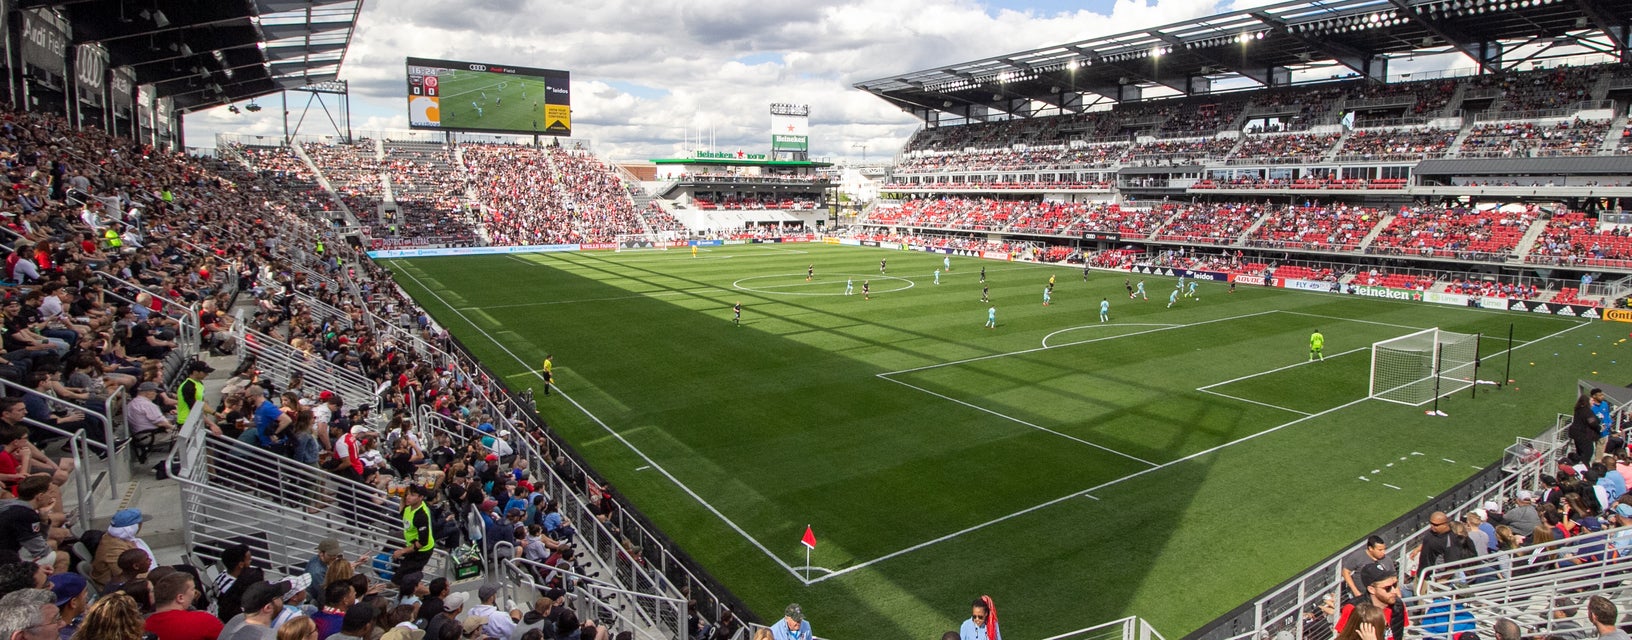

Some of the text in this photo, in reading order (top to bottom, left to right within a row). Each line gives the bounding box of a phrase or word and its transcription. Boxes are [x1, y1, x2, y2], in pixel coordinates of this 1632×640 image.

[23, 18, 46, 48] Audi
[696, 150, 734, 158] Heineken
[1193, 271, 1214, 281] leidos
